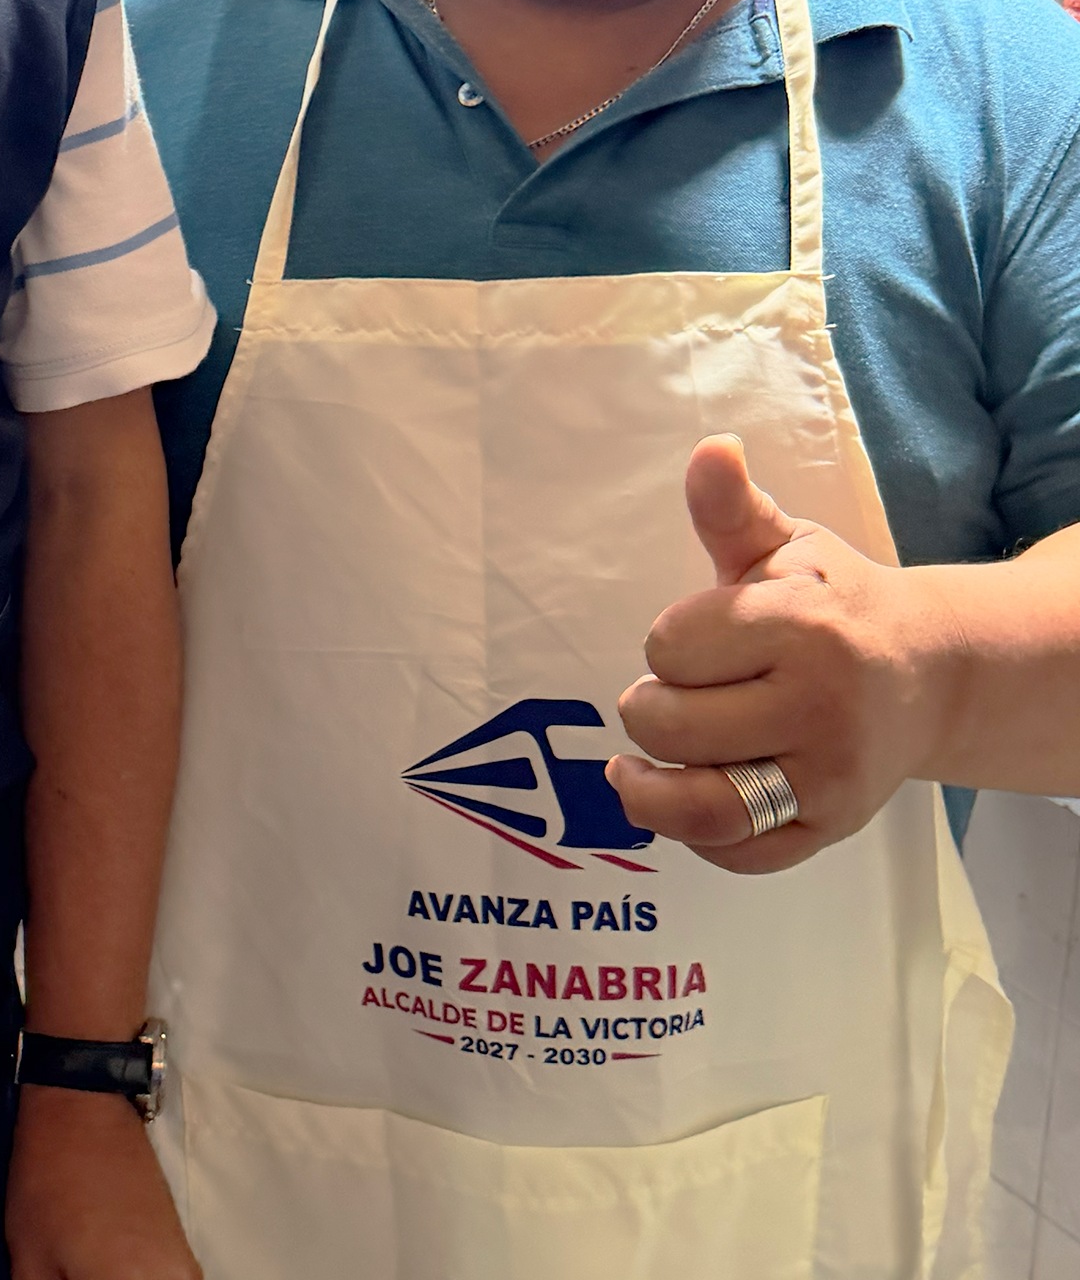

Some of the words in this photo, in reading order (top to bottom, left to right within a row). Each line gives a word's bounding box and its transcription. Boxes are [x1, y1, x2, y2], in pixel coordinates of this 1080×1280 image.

[407, 890, 559, 930] AVANZA
[570, 893, 659, 933] PAÍS
[362, 942, 444, 988] JOE
[458, 956, 708, 1002] ZANABRIA
[361, 986, 478, 1029] ALCALDE
[486, 1009, 526, 1036] DE
[533, 1014, 574, 1040] LA
[579, 1007, 707, 1041] VICTORIA
[459, 1035, 520, 1061] 2027
[543, 1047, 608, 1066] 2030
